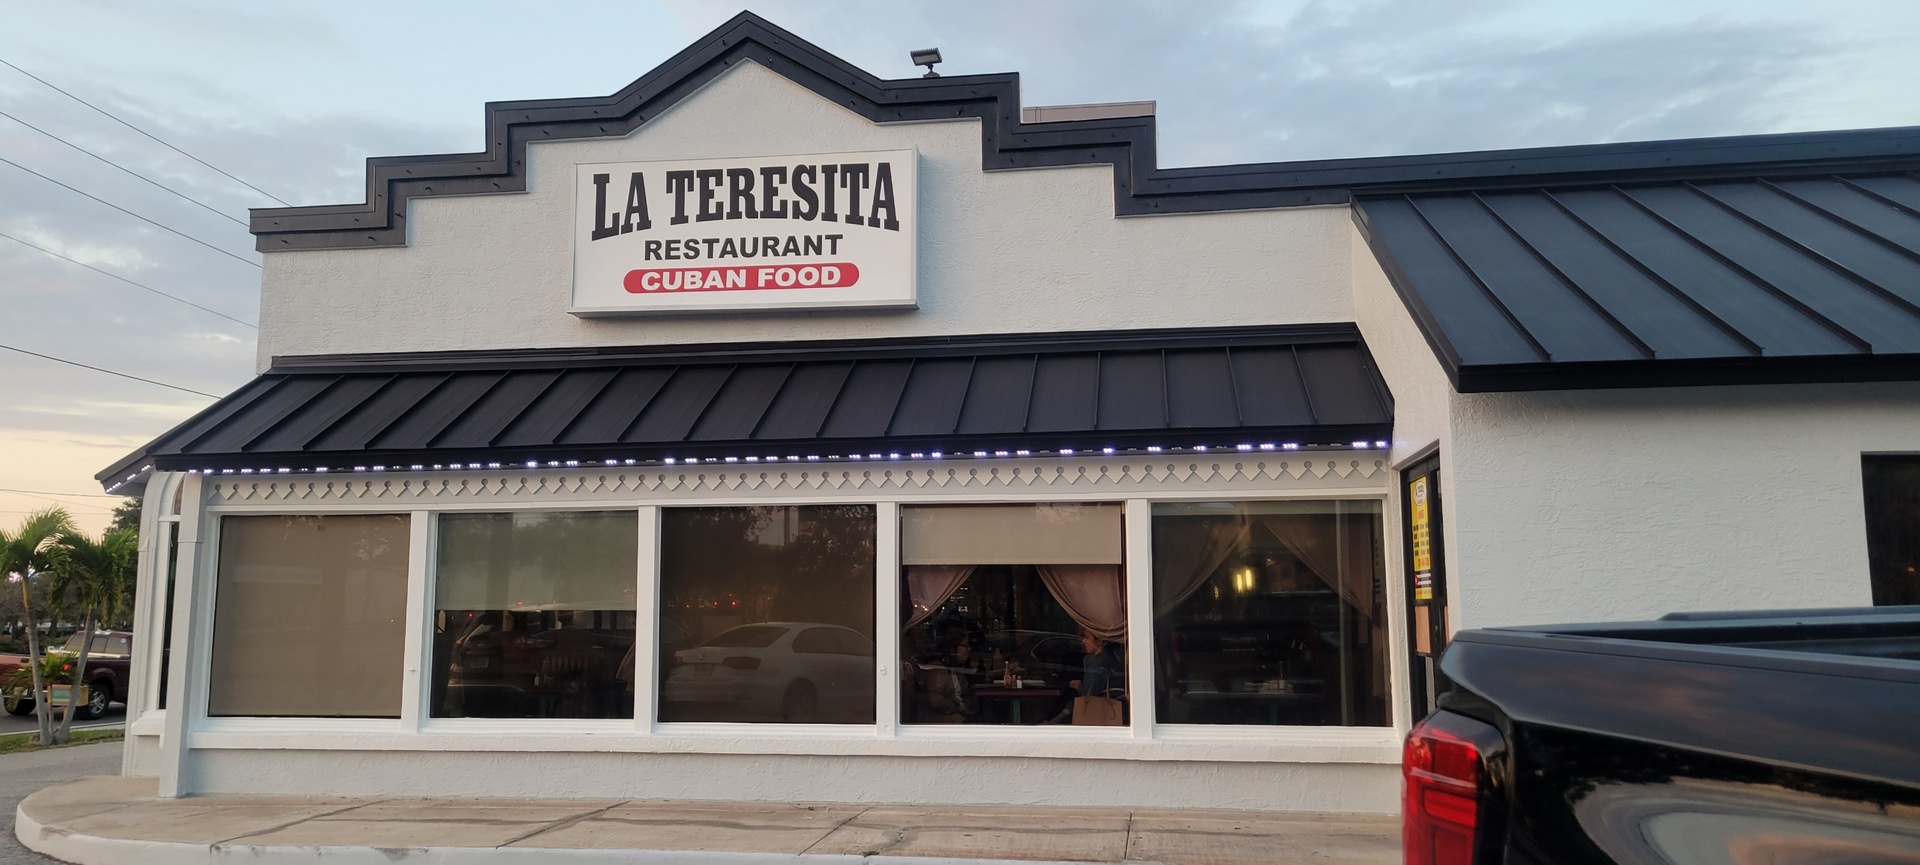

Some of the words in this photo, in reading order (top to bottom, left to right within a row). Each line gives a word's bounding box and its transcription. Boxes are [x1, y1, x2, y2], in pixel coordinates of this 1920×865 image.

[591, 171, 652, 241] LA
[665, 162, 899, 232] TERESITA
[644, 233, 843, 261] RESTAURANT
[641, 268, 746, 291] CUBAN
[757, 266, 841, 287] FOOD
